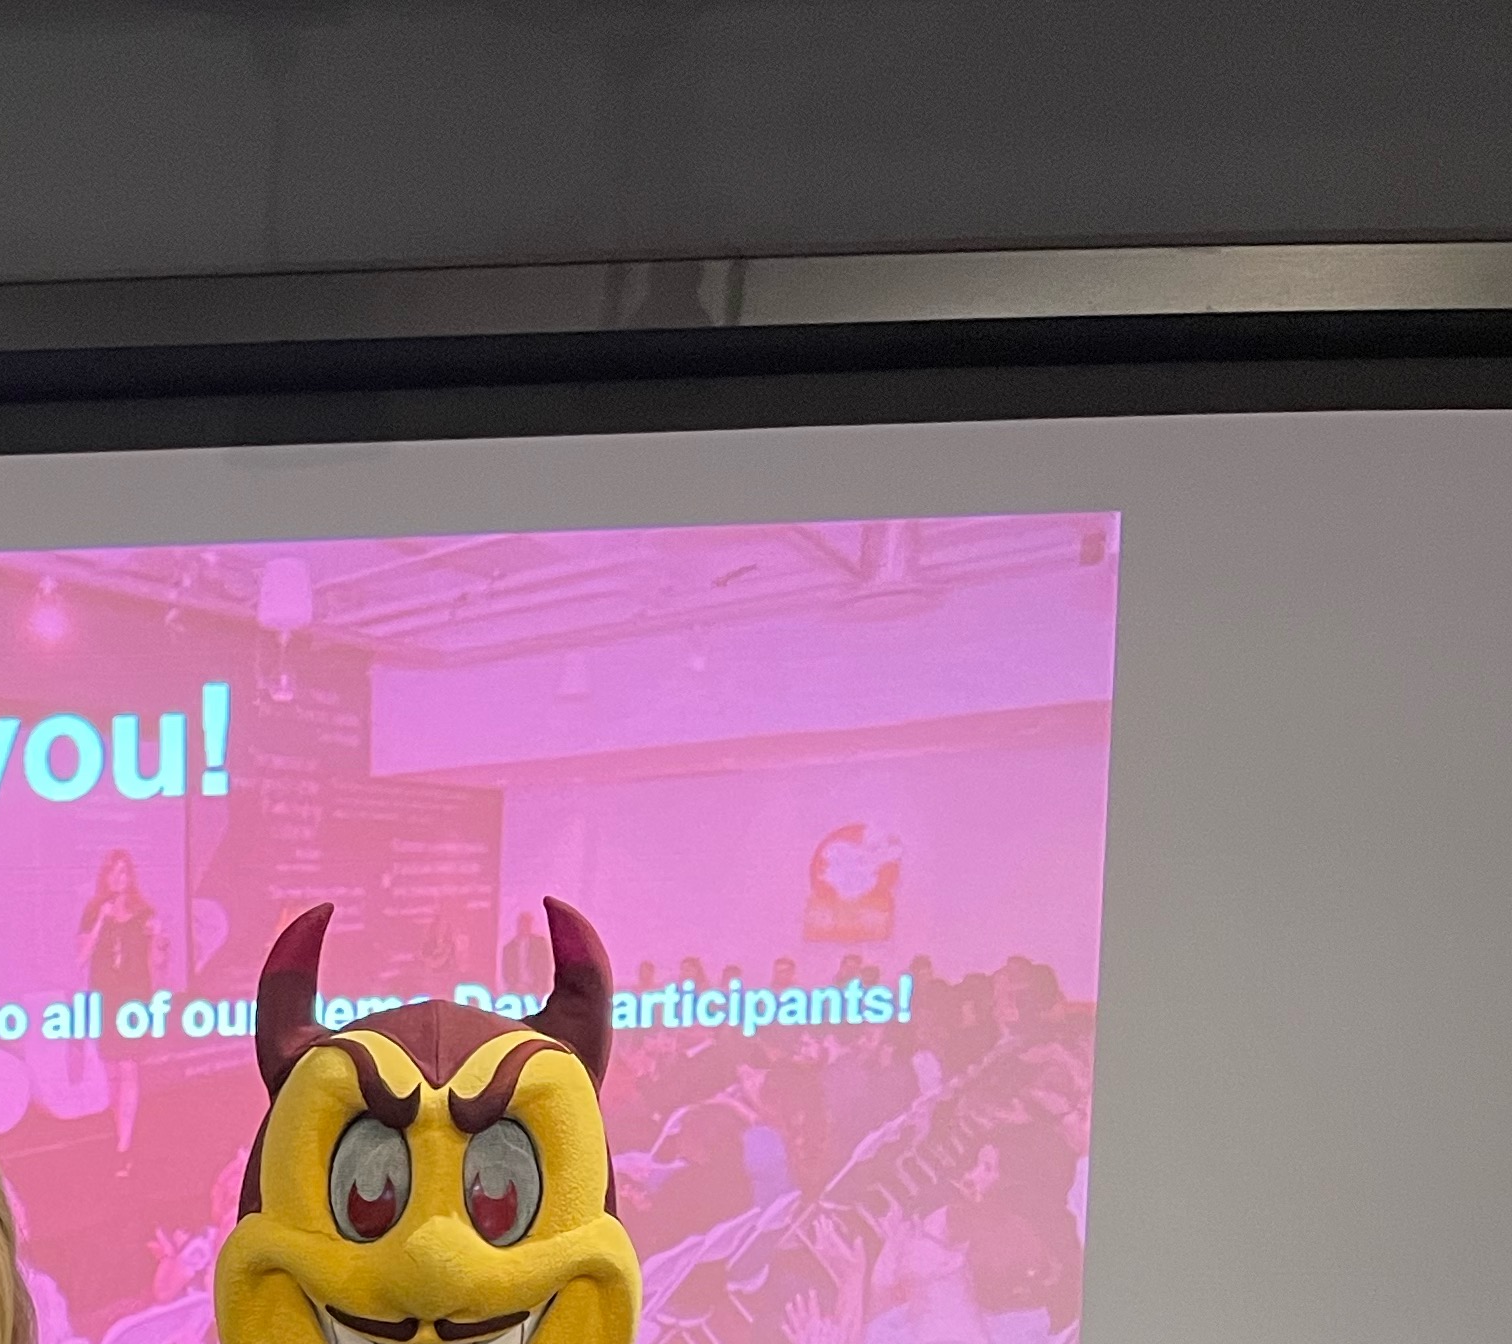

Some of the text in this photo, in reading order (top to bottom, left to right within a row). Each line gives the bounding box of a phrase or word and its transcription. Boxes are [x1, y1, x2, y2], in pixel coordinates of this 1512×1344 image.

[40, 988, 105, 1040] all
[113, 987, 174, 1042] of
[611, 975, 912, 1036] articipants!
